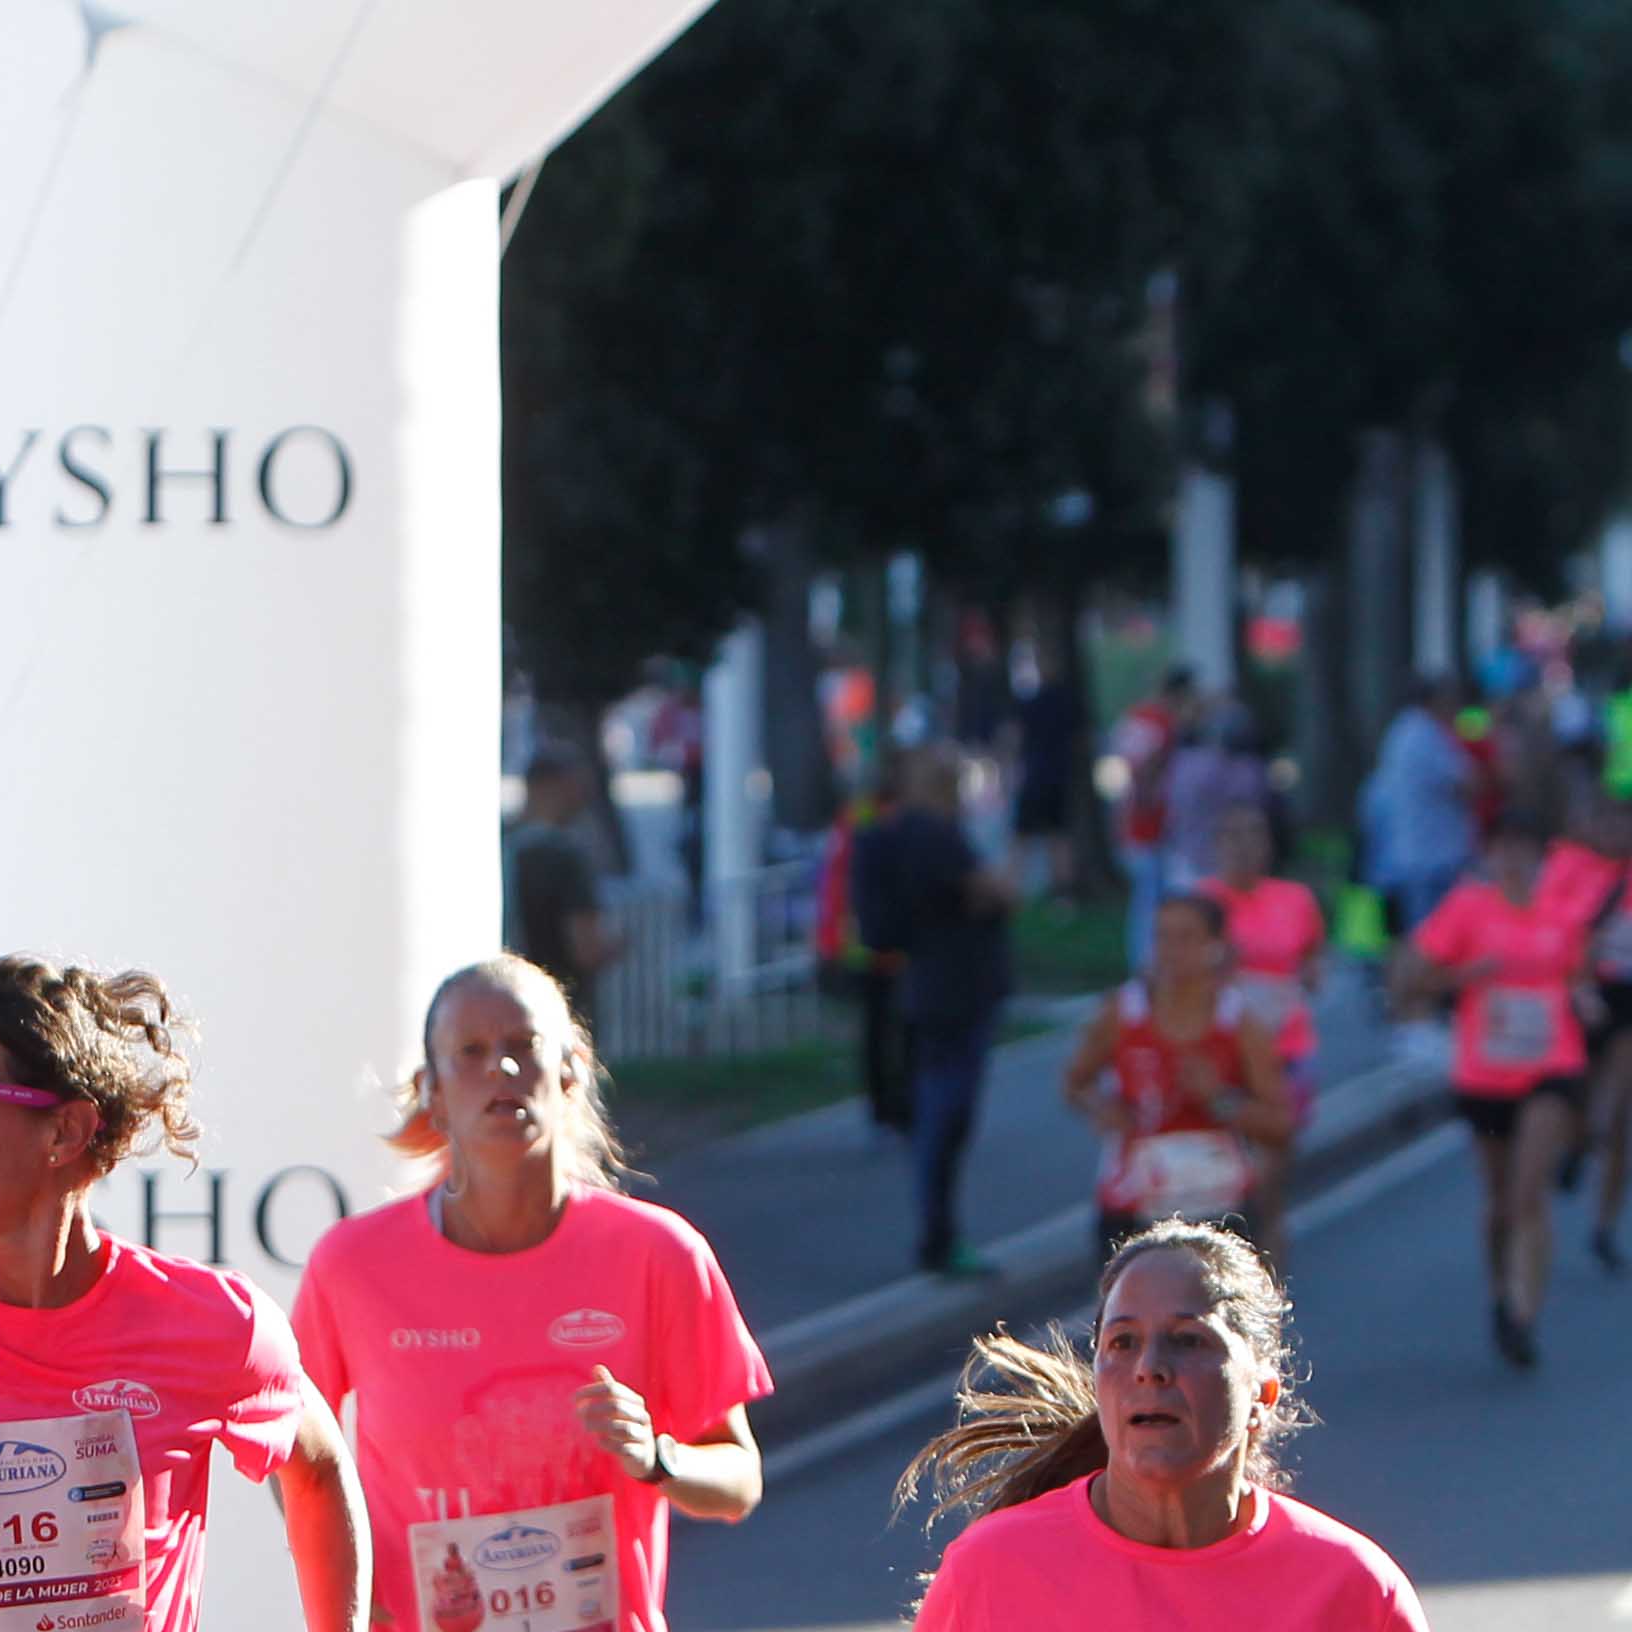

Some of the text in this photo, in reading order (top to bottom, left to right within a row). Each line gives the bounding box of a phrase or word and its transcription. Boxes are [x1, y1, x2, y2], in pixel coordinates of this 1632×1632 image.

[390, 1327, 480, 1350] OYSHO
[81, 1390, 155, 1410] ASTURIANA
[75, 1441, 119, 1460] SUMA
[15, 1587, 34, 1601] LA
[38, 1581, 89, 1598] MUJER
[94, 1575, 123, 1593] 2023
[490, 1580, 556, 1614] 016
[57, 1606, 127, 1631] Santander
